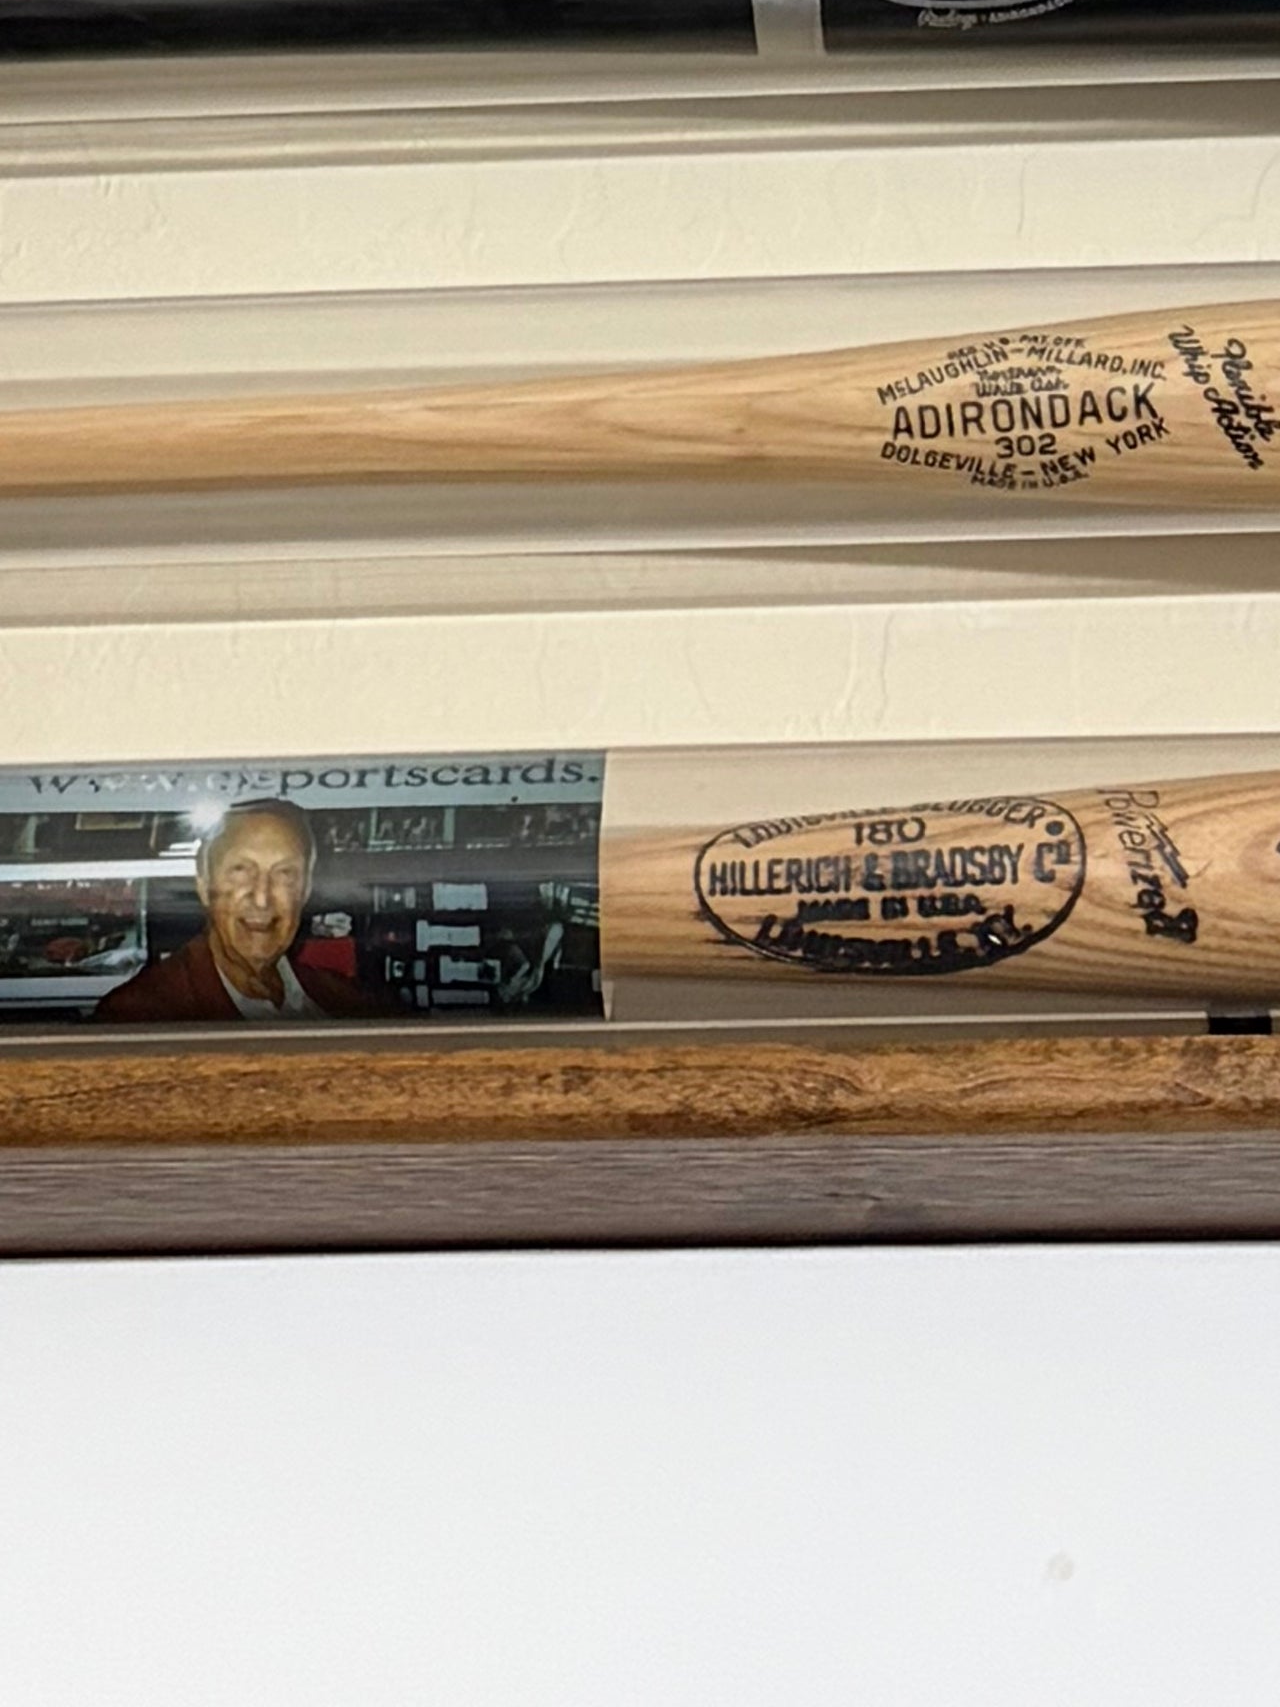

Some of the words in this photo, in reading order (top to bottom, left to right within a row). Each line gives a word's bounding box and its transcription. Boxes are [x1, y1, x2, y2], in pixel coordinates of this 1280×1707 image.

[891, 380, 1162, 441] ADIRONDACK
[879, 439, 1019, 480] DOLGEVILLE
[1040, 446, 1098, 481] NEW
[1104, 416, 1172, 457] YORK
[993, 432, 1060, 460] 302
[853, 816, 926, 847] 180
[707, 854, 852, 898] HILLERICH
[890, 844, 1024, 888] BRADSBY
